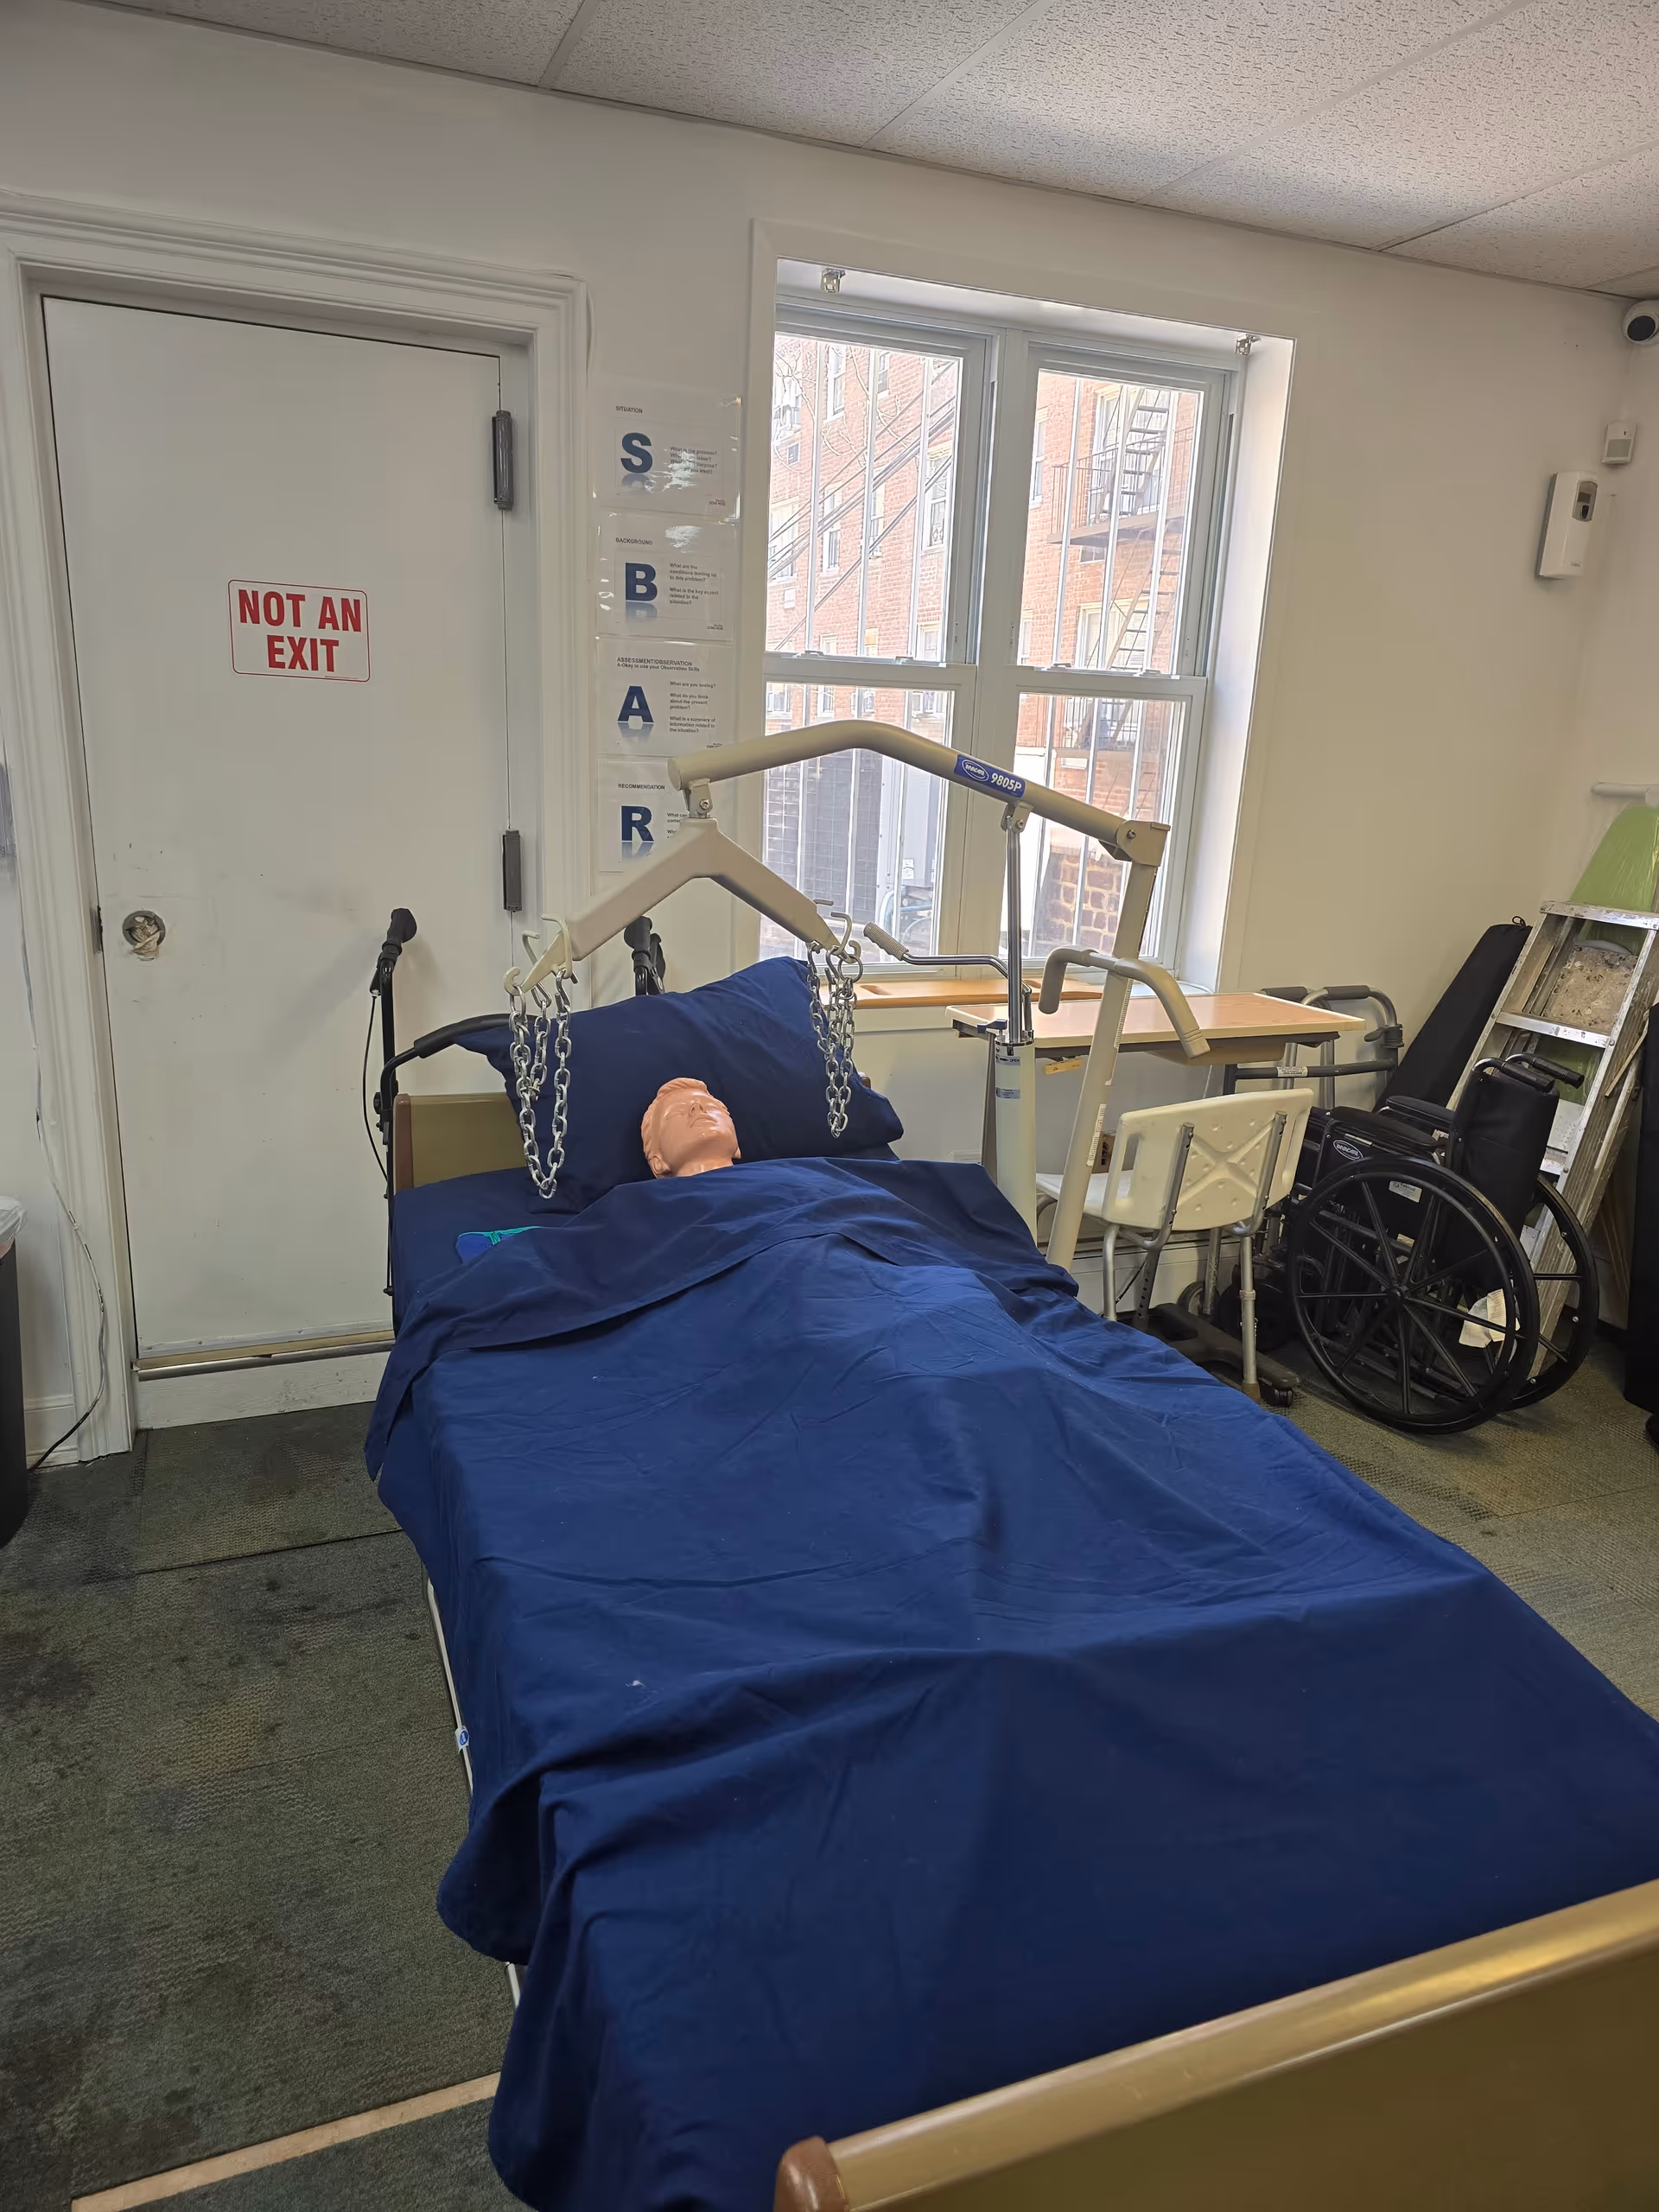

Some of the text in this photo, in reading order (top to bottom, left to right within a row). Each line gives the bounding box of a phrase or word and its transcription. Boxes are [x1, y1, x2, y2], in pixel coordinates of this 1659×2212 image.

[615, 405, 643, 414] SITUATION
[620, 432, 653, 474] S
[615, 537, 653, 546] BACKGROUND
[625, 562, 658, 601] B
[238, 588, 362, 632] NOT AN
[267, 634, 339, 673] EXIT
[616, 657, 693, 666] ASSESSMENT/OBSERVATION
[617, 685, 654, 722] A
[990, 772, 1022, 791] 9805P
[620, 804, 655, 842] R
